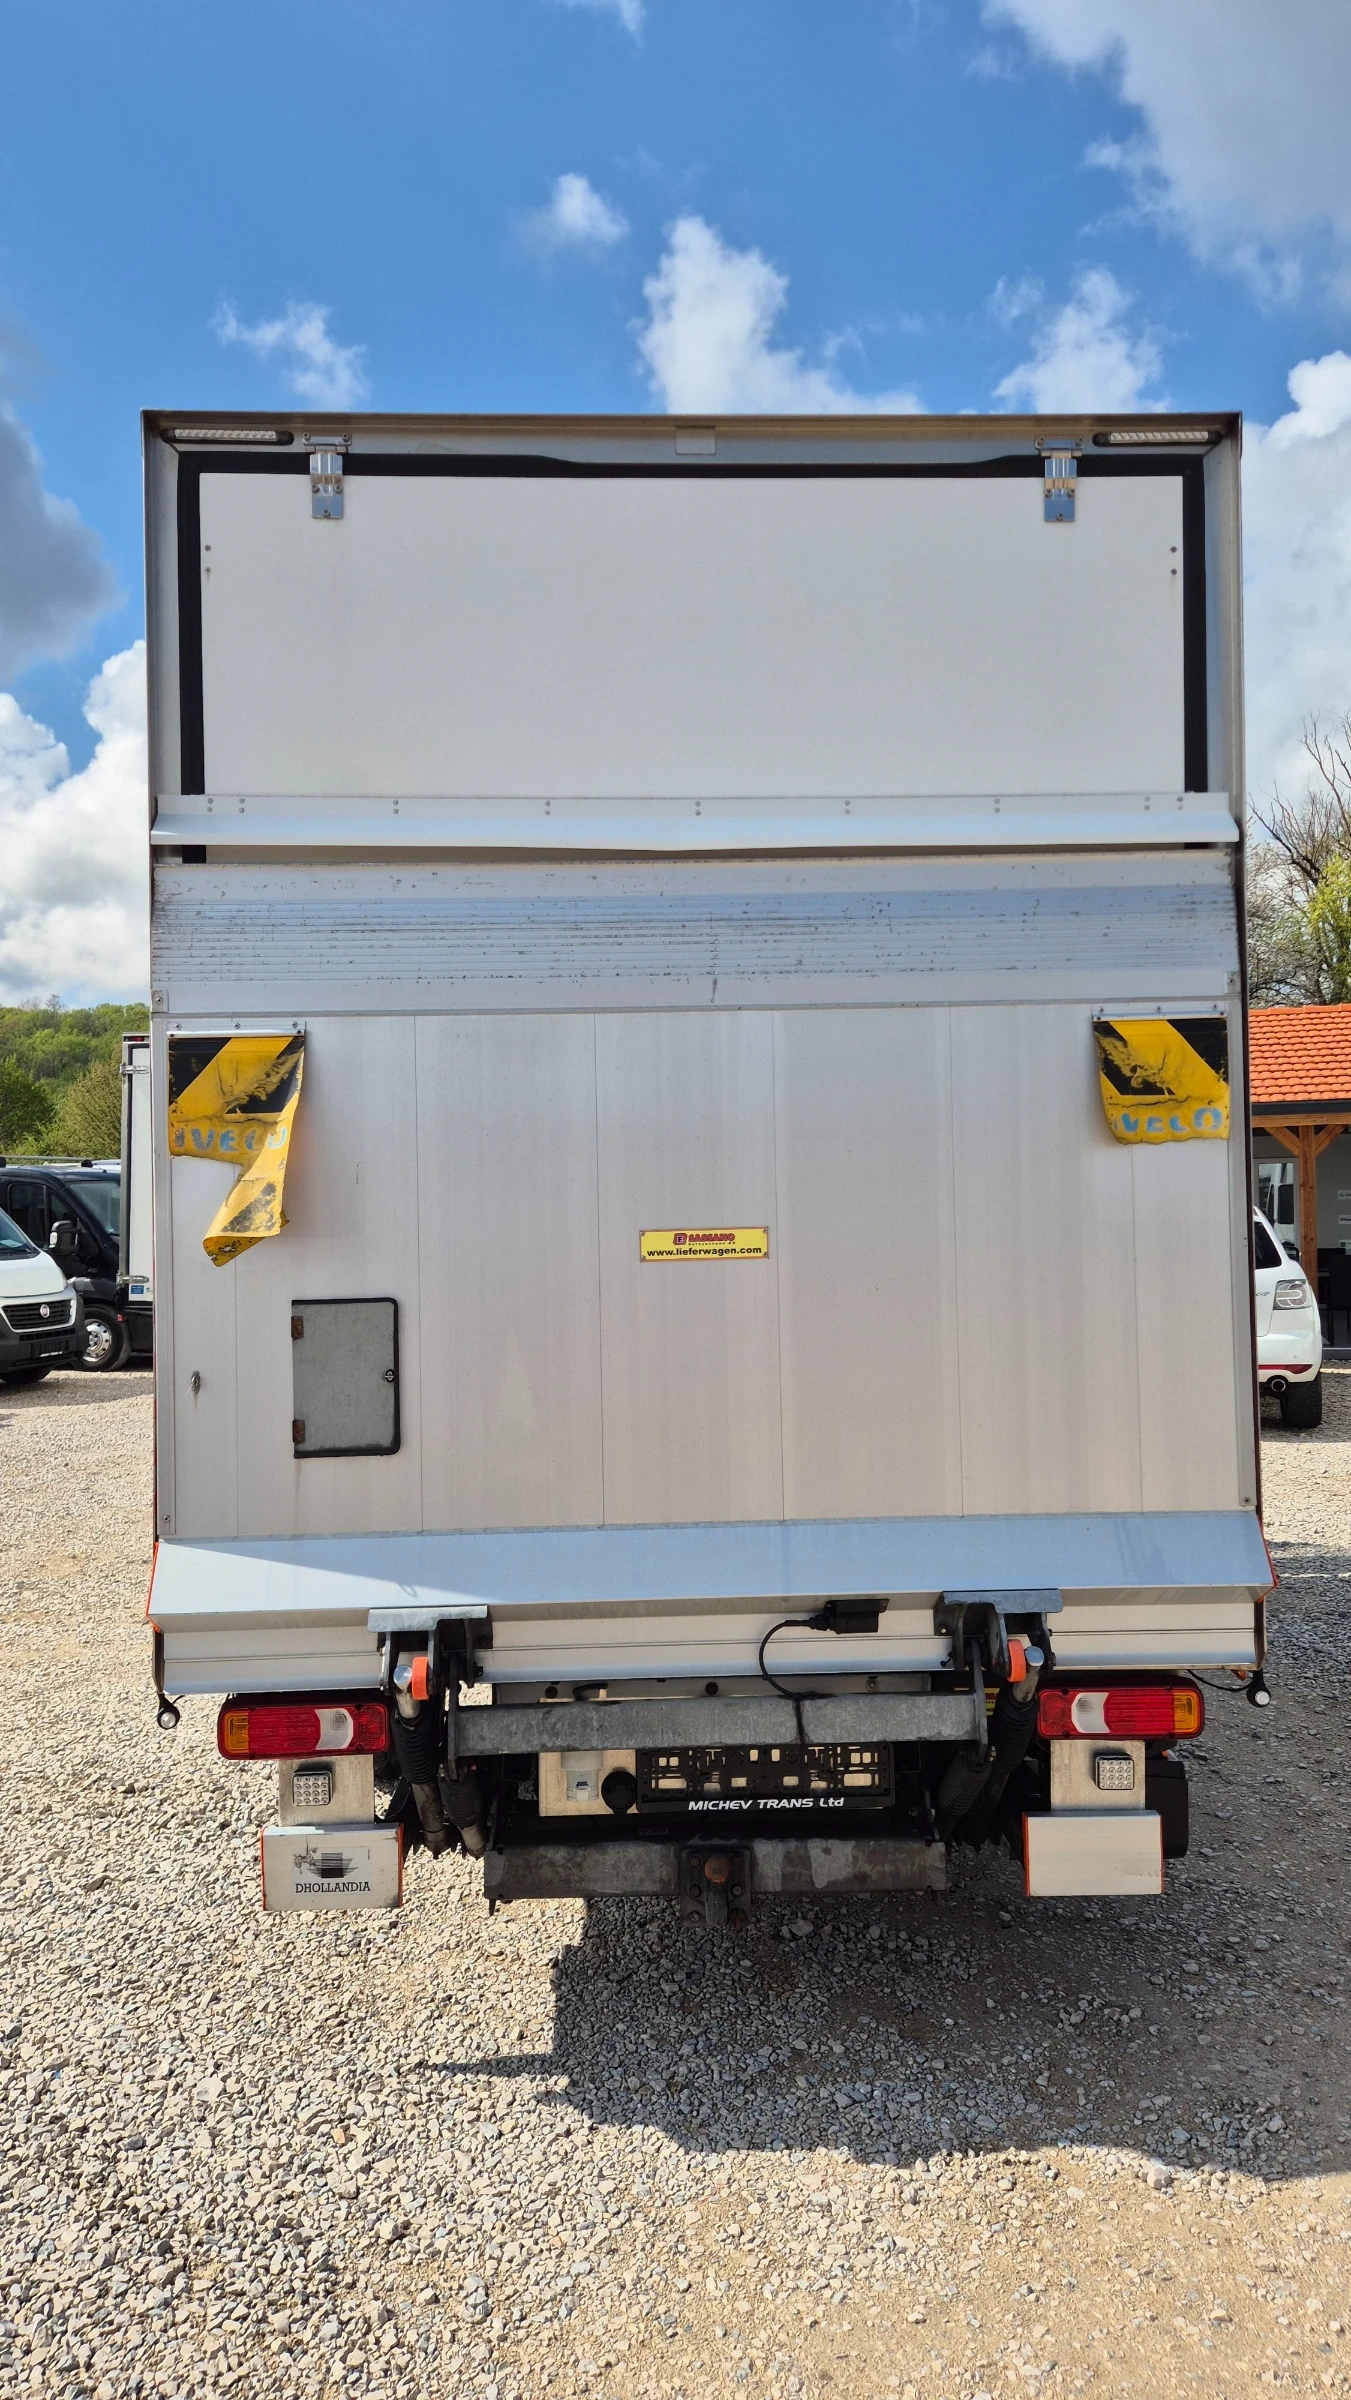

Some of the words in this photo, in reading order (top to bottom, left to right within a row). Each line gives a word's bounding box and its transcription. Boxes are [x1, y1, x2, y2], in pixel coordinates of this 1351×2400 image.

[647, 1247, 762, 1256] www.lieferwagen.com
[688, 1800, 753, 1811] MICHEV
[757, 1798, 814, 1809] TRANS
[819, 1797, 845, 1807] Ltd
[295, 1881, 371, 1894] DHOLLANDIA
